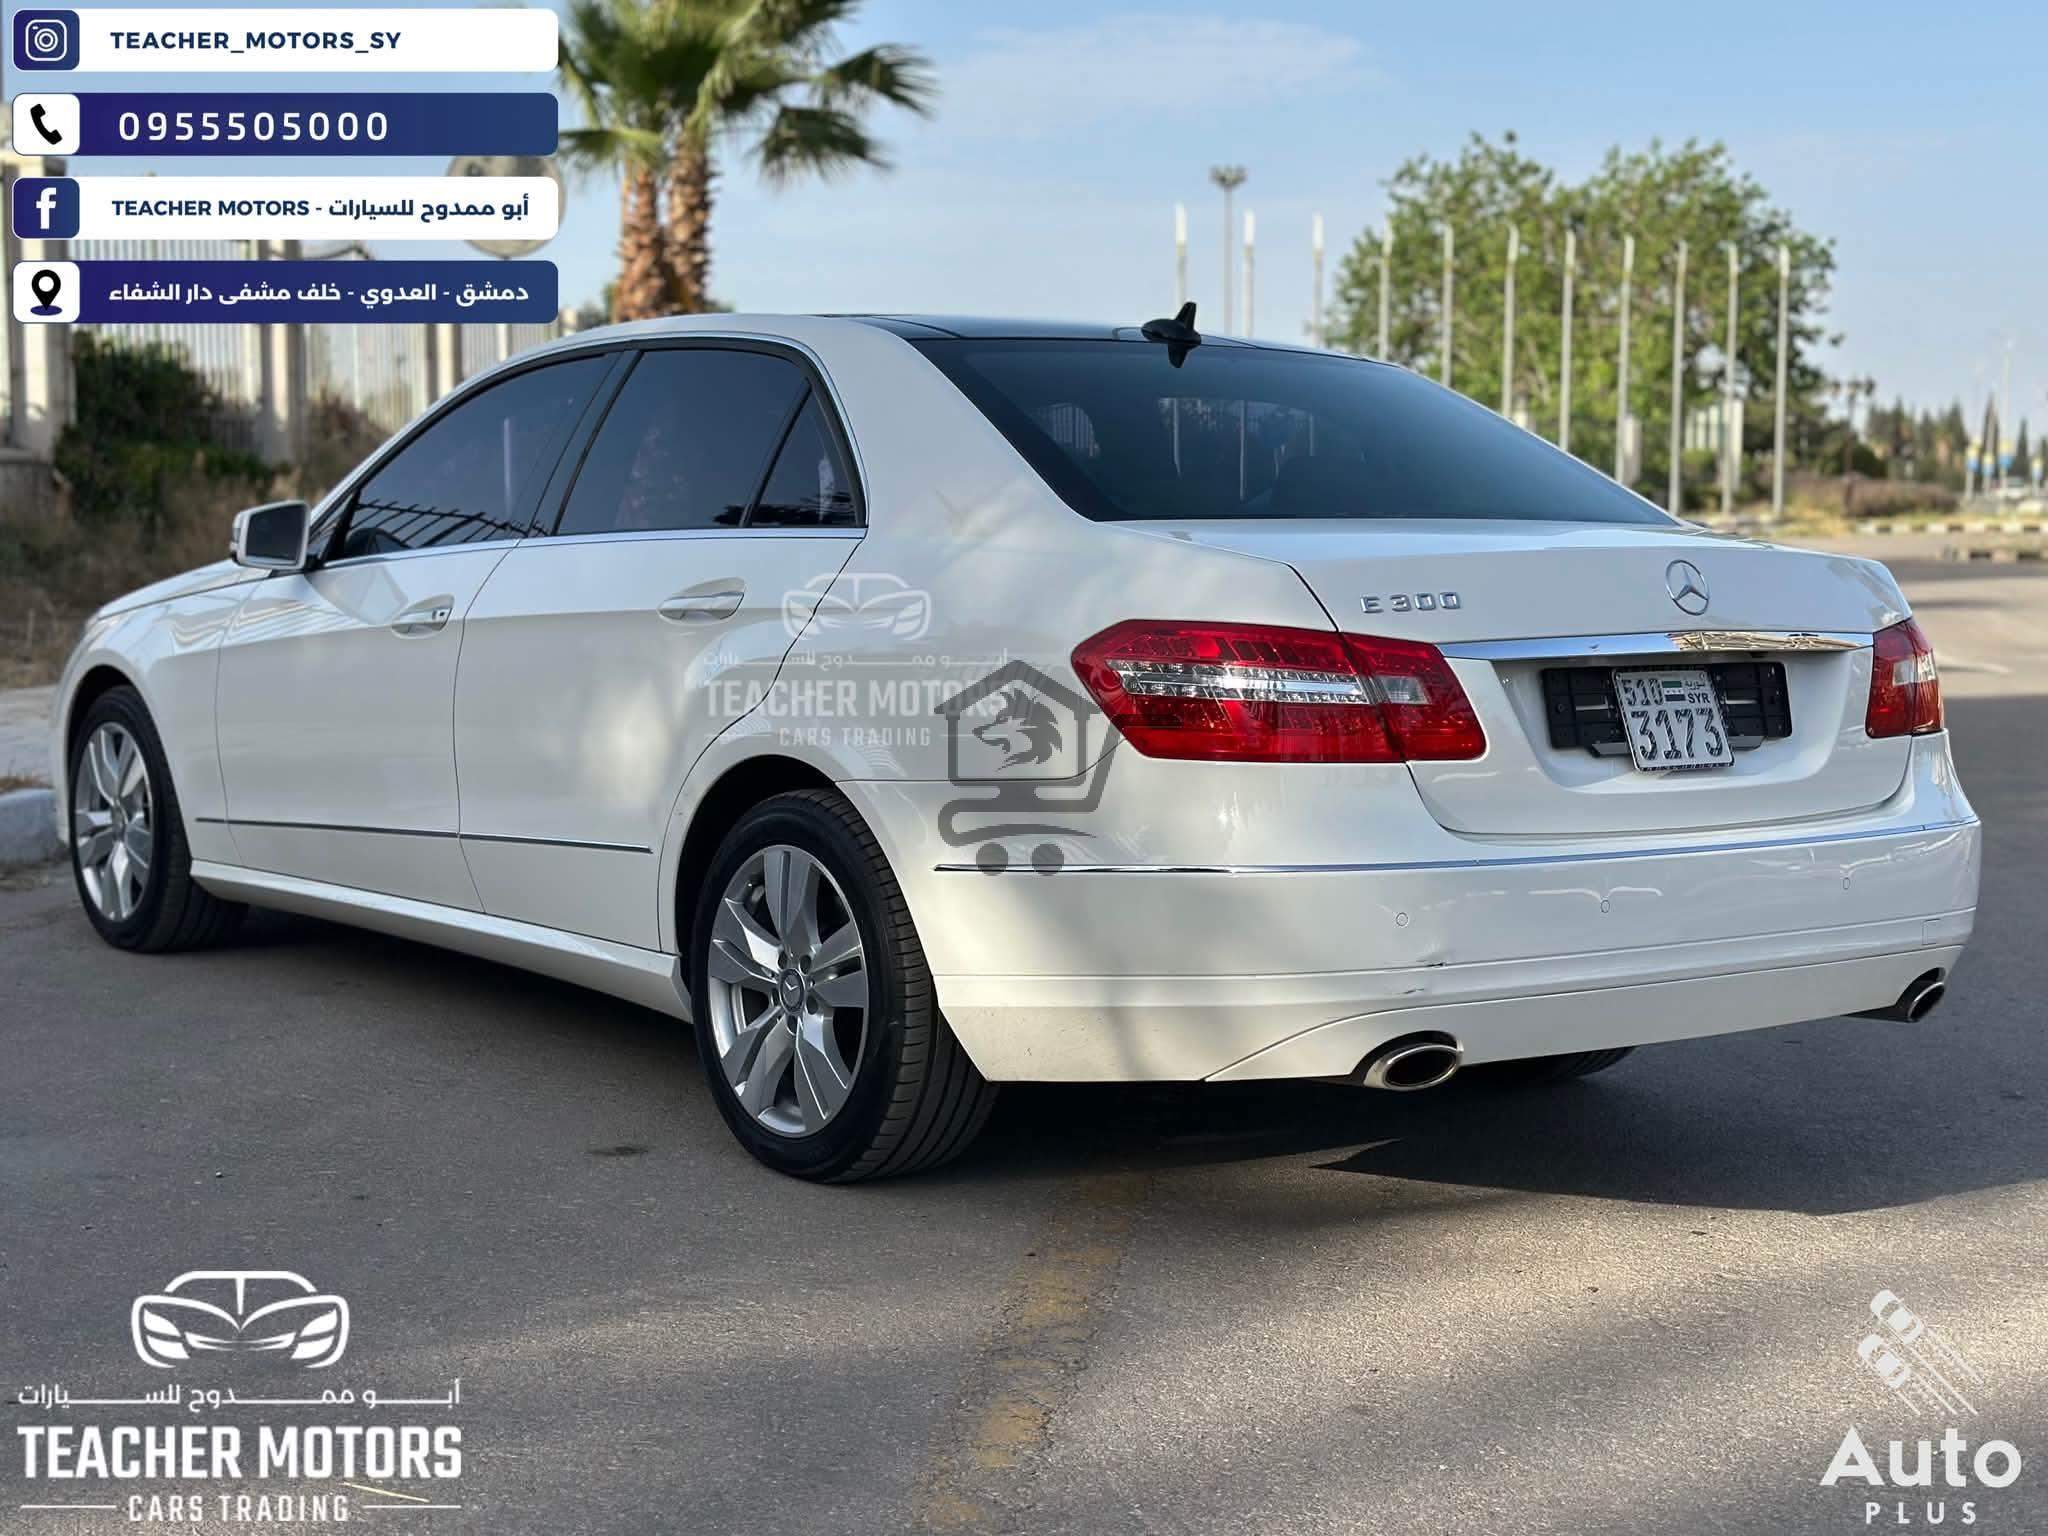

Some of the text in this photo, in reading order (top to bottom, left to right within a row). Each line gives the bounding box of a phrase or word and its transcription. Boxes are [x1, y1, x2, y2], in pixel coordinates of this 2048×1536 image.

[1361, 590, 1463, 614] E 300
[1687, 691, 1711, 704] SYR
[1631, 707, 1724, 761] 3173
